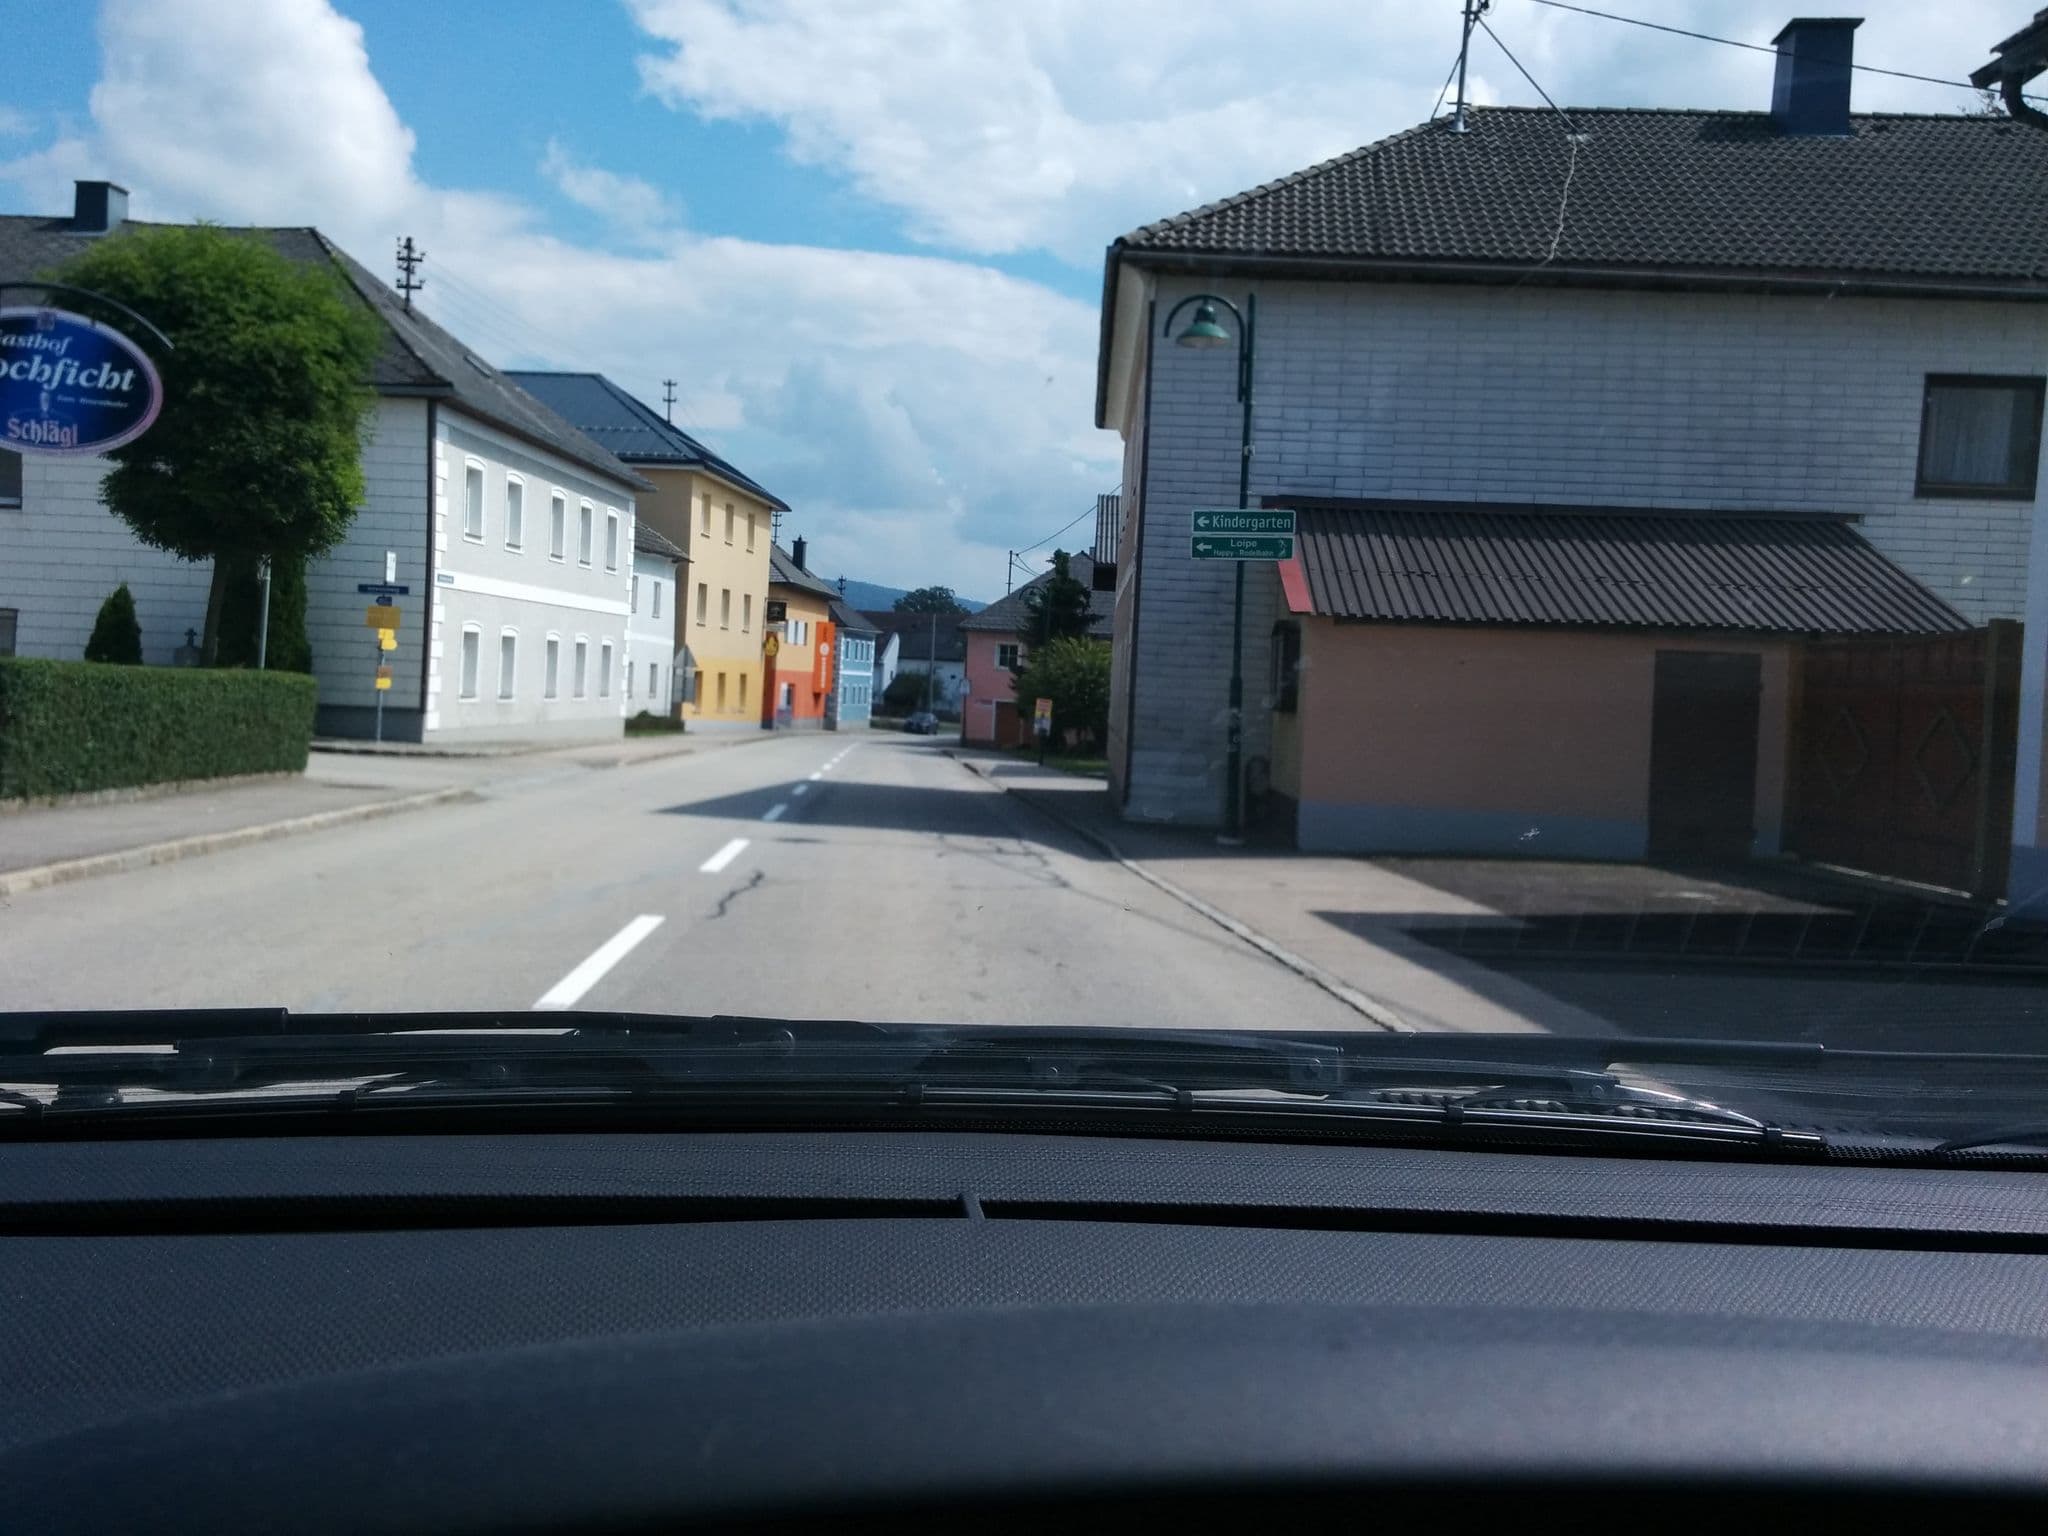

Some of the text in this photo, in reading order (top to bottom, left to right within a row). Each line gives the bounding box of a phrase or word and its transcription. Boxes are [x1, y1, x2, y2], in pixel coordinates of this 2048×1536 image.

[0, 331, 73, 357] asthof
[8, 417, 78, 447] Schlägl
[1212, 514, 1291, 531] Kindergarten
[1230, 538, 1257, 549] Loipe
[1213, 549, 1234, 558] Happy
